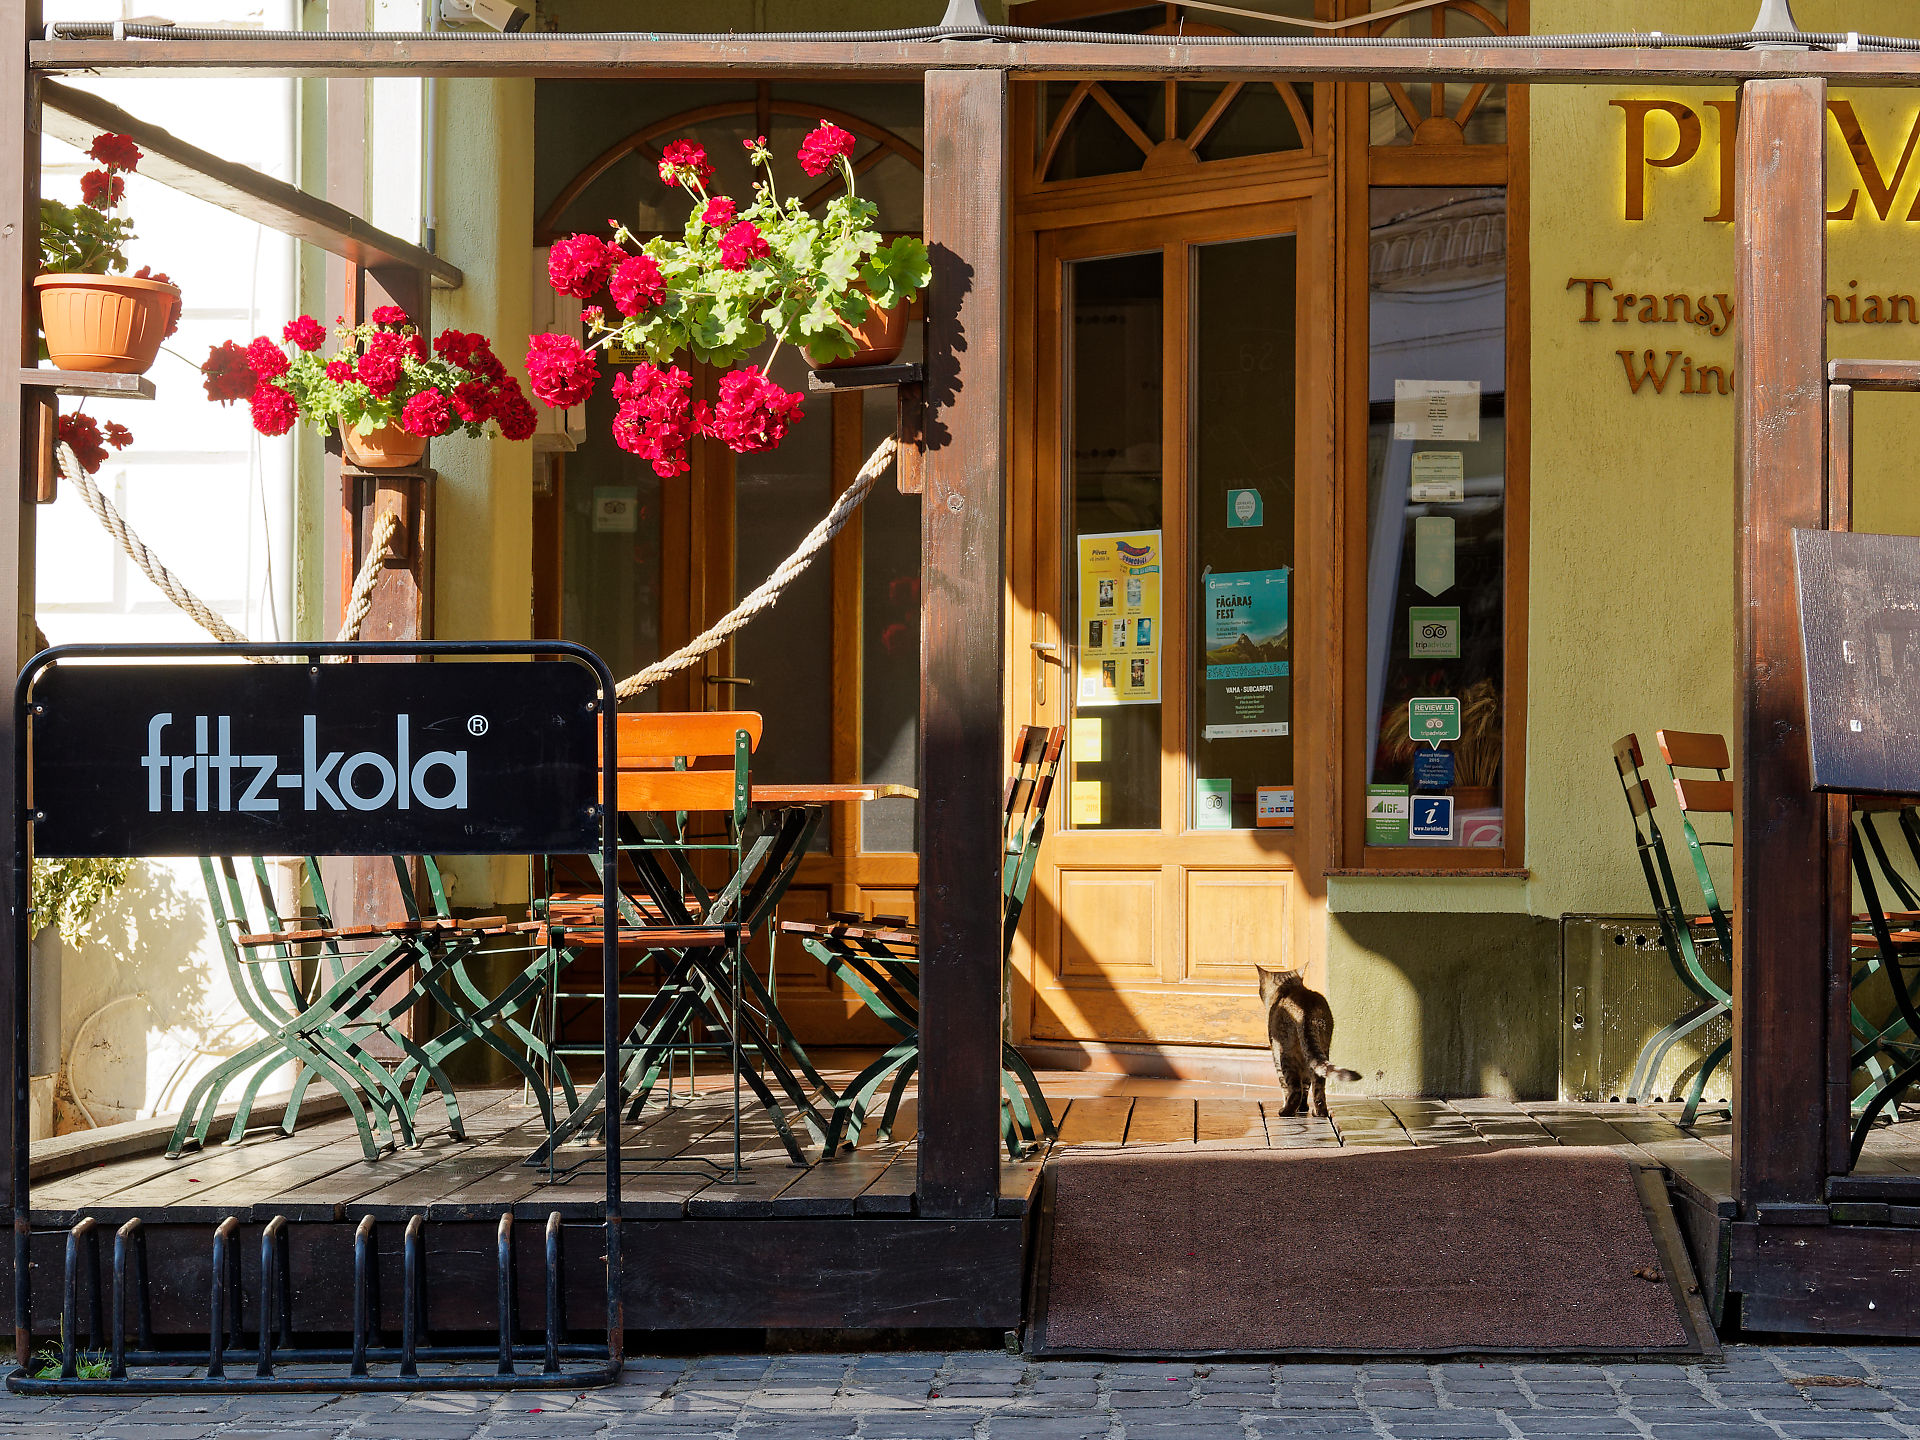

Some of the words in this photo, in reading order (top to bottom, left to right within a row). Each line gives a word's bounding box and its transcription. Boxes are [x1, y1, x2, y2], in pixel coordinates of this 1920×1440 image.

[1609, 99, 1920, 221] PIV
[1616, 349, 1735, 395] Win
[1216, 608, 1235, 619] FEST
[1415, 641, 1453, 649] tripadvisor
[1383, 803, 1399, 814] IGF
